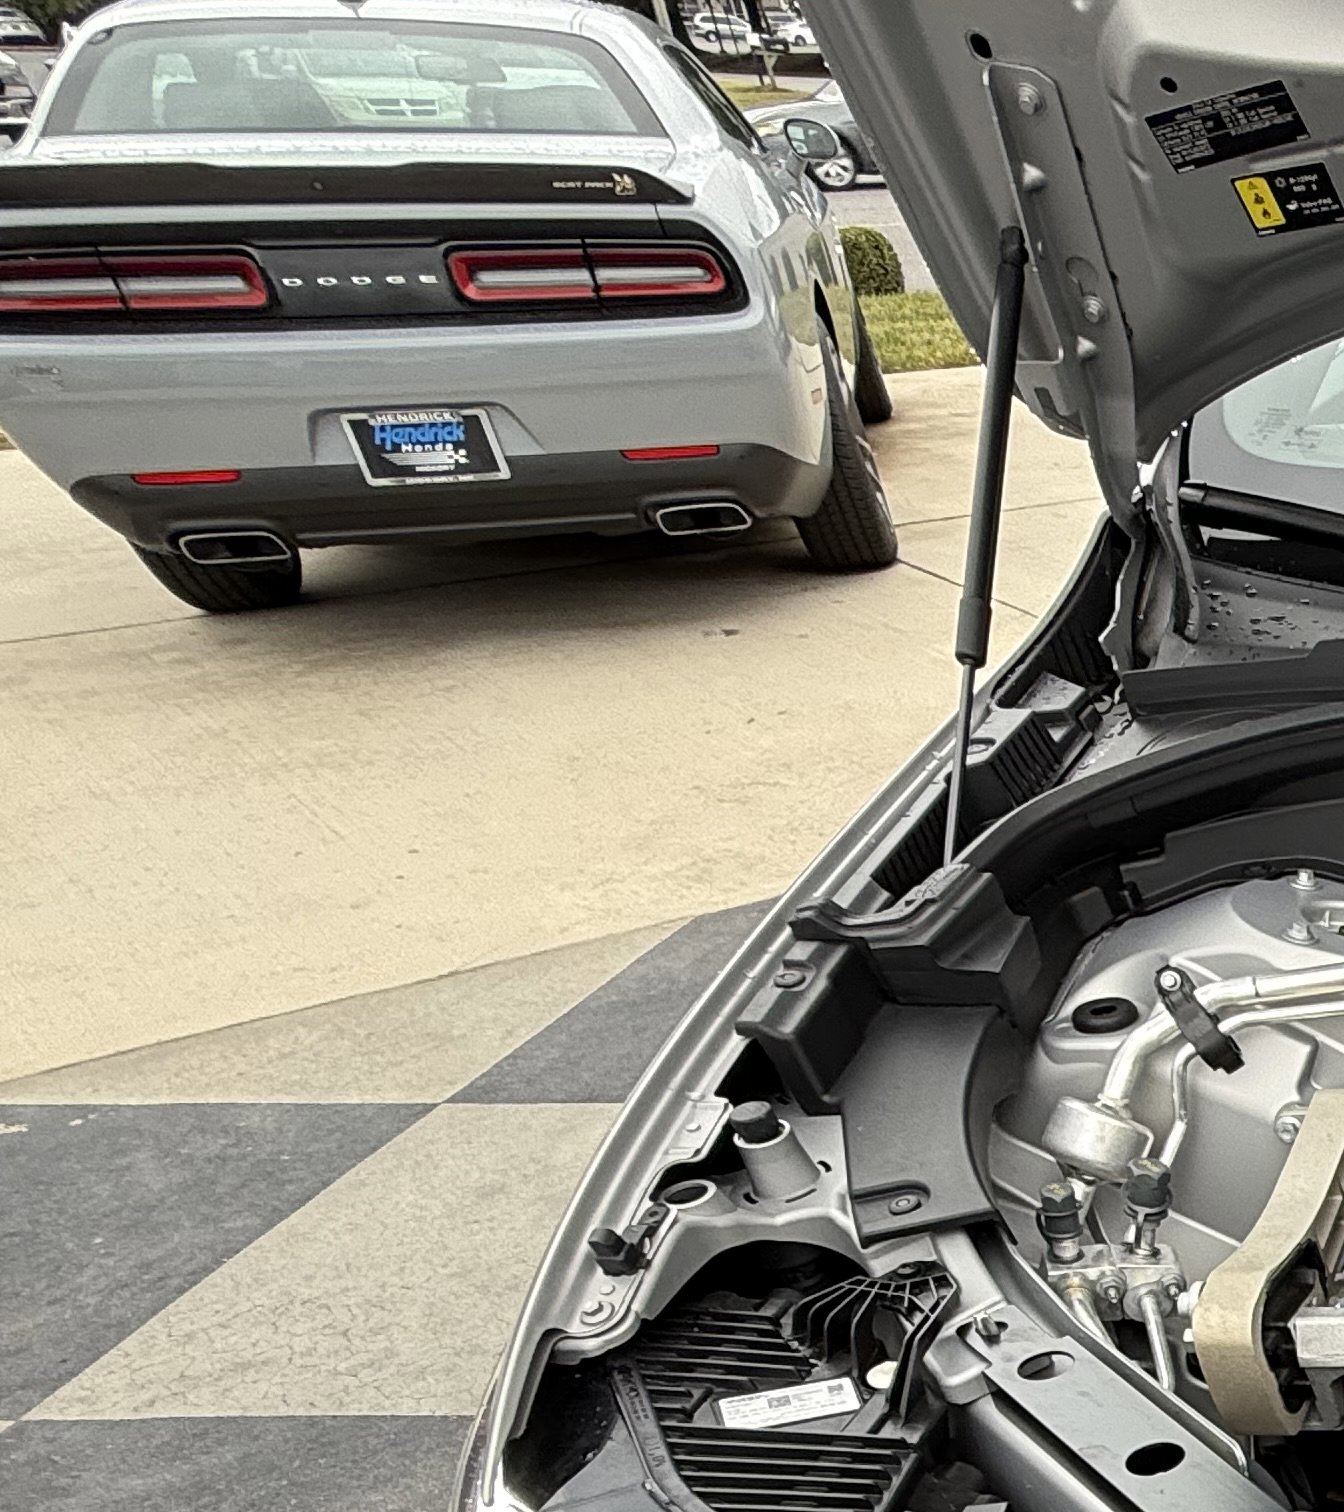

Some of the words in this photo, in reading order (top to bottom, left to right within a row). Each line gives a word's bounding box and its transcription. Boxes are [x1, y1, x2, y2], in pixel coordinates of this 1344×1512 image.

[281, 274, 439, 287] DODGE
[375, 411, 454, 424] HENDRICK
[374, 422, 465, 451] Hendrick
